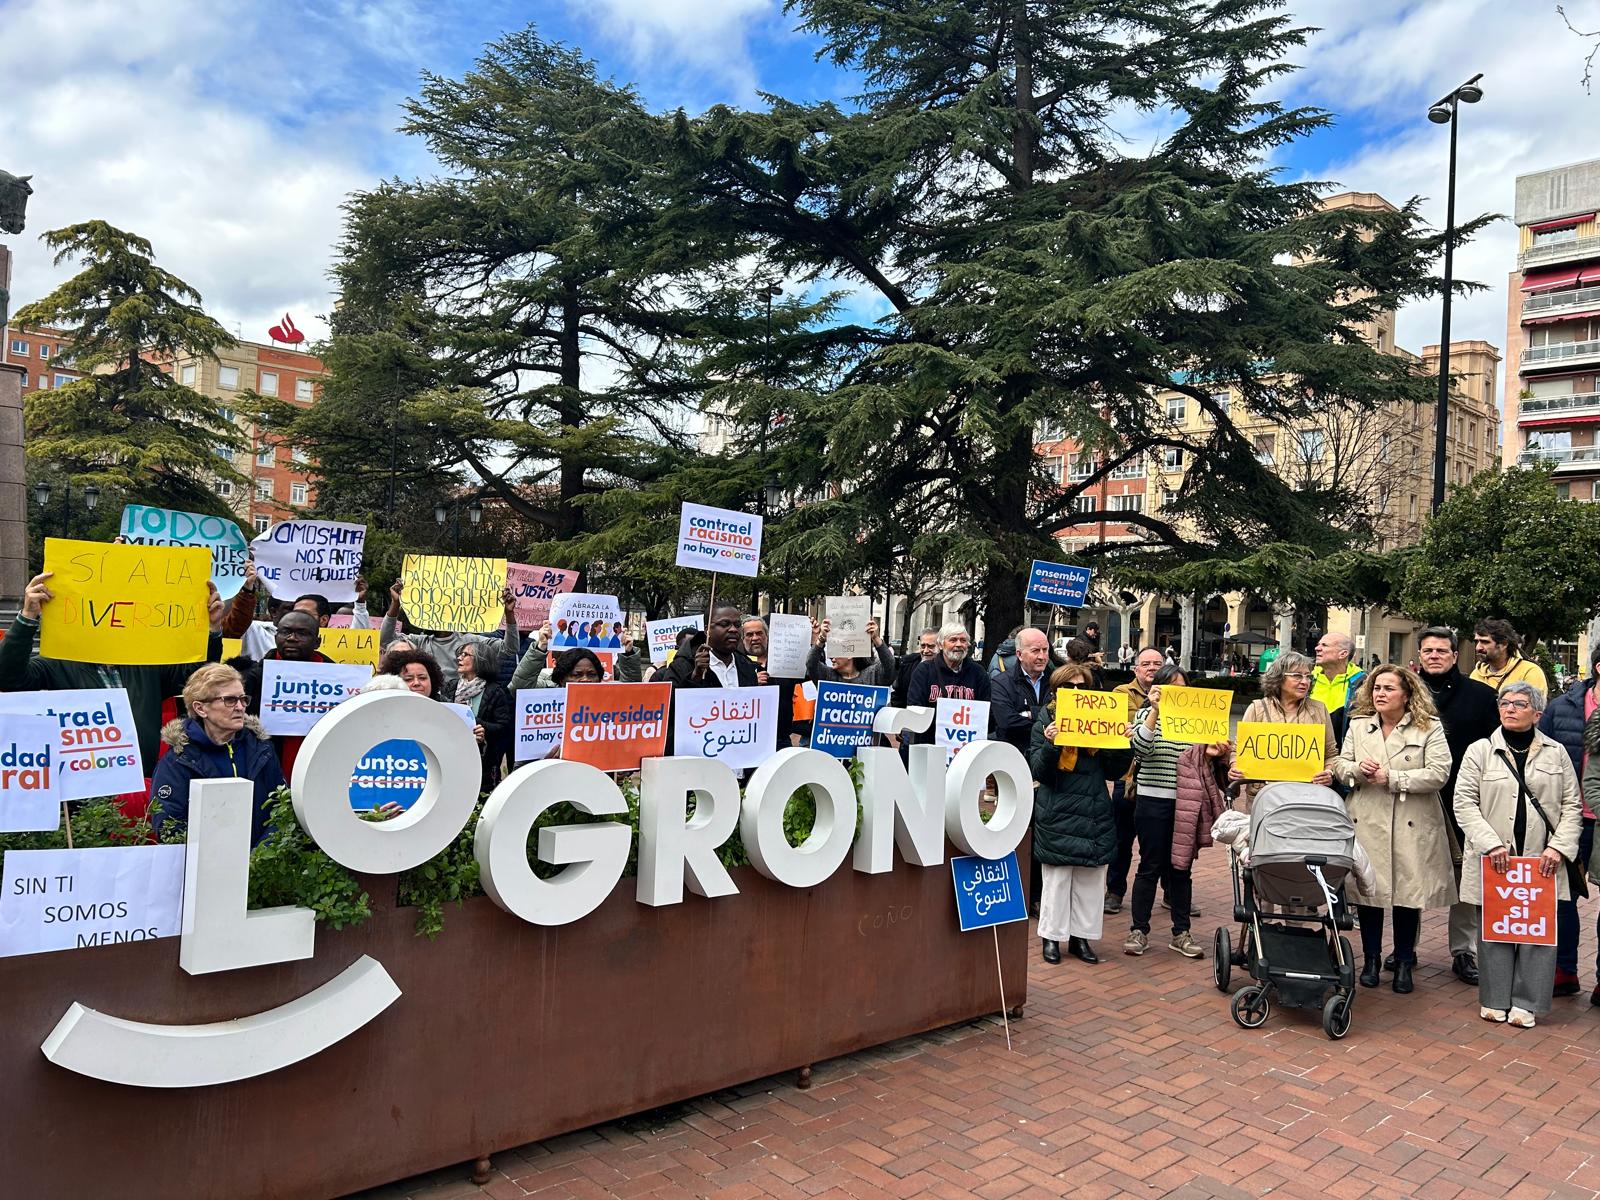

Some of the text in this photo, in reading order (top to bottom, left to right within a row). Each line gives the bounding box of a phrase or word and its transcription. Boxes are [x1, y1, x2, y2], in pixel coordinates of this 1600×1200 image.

[126, 505, 246, 551] TODOS
[689, 526, 753, 546] racismo
[296, 548, 363, 566] NOS ANTES
[683, 542, 756, 562] no hay colores
[128, 558, 148, 583] A
[165, 558, 193, 584] LA
[256, 565, 281, 580] QUE
[1036, 569, 1086, 583] ensemble
[566, 610, 614, 620] DIVERSIDAD
[571, 602, 600, 610] ABRAZA
[337, 634, 348, 648] A
[357, 635, 373, 649] LA
[272, 675, 361, 698] juntos vs
[1072, 693, 1118, 709] PARAD
[1165, 691, 1228, 711] NO A LAS
[571, 703, 665, 725] diversidad
[689, 698, 760, 734] الثقافي
[820, 703, 874, 724] racism
[953, 706, 971, 725] di
[569, 719, 663, 742] cultural
[1060, 718, 1074, 732] EL
[1166, 716, 1228, 736] PERSONAS
[521, 734, 534, 742] no
[536, 730, 557, 743] hay
[702, 722, 757, 757] التنوع
[945, 728, 977, 743] ver
[1239, 733, 1321, 761] ACOGIDA
[69, 752, 136, 772] colores
[180, 690, 1033, 976] LOGROÑO
[962, 861, 1009, 896] الثقافي
[1506, 863, 1531, 883] di
[14, 876, 73, 895] SIN TI
[1495, 886, 1543, 900] ver
[975, 882, 1011, 916] التنوع
[44, 901, 128, 923] SOMOS
[1509, 900, 1529, 919] si
[1492, 915, 1546, 936] dad
